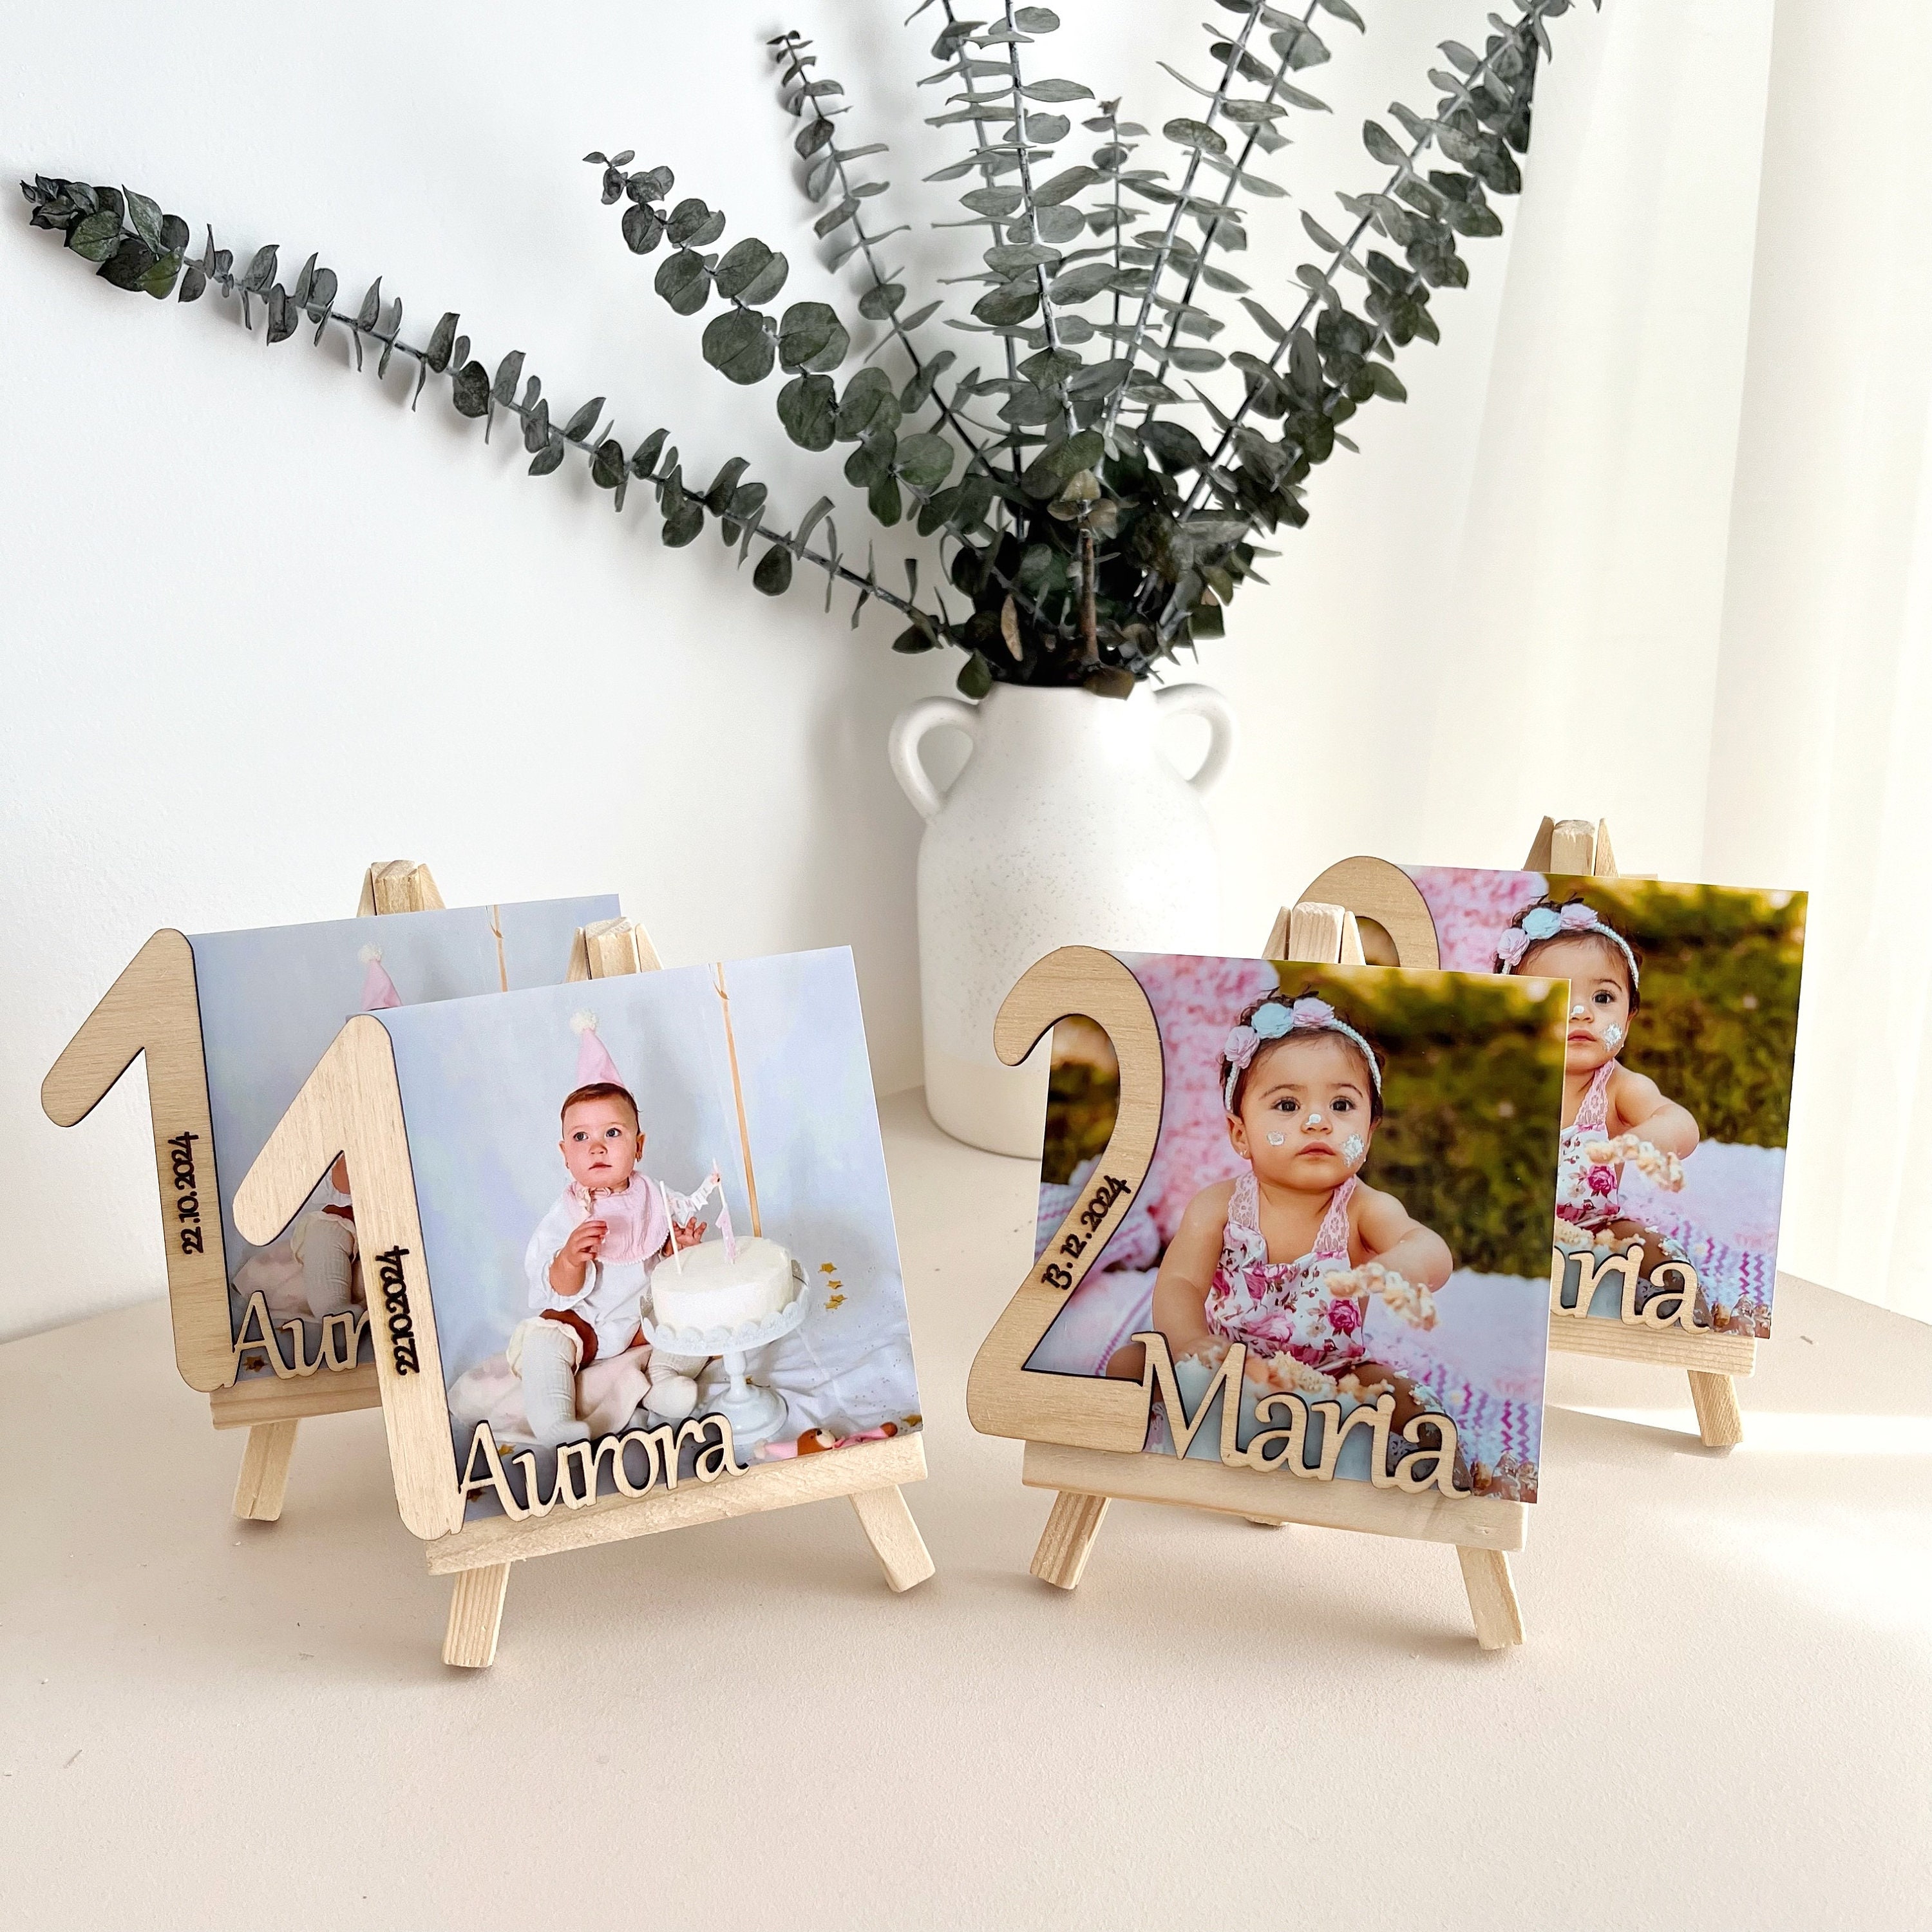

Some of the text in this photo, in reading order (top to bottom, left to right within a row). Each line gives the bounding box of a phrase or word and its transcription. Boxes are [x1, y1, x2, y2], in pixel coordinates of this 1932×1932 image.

[41, 928, 237, 1392] 1
[167, 1131, 205, 1255] 22.10.2024
[967, 946, 1164, 1451] 2
[232, 1014, 465, 1541] 1
[1041, 1175, 1132, 1290] 13.12.2024
[1549, 1242, 1711, 1335] ria
[233, 1289, 371, 1380] Aur
[459, 1412, 750, 1522] Aurora
[1131, 1331, 1472, 1500] Maria
